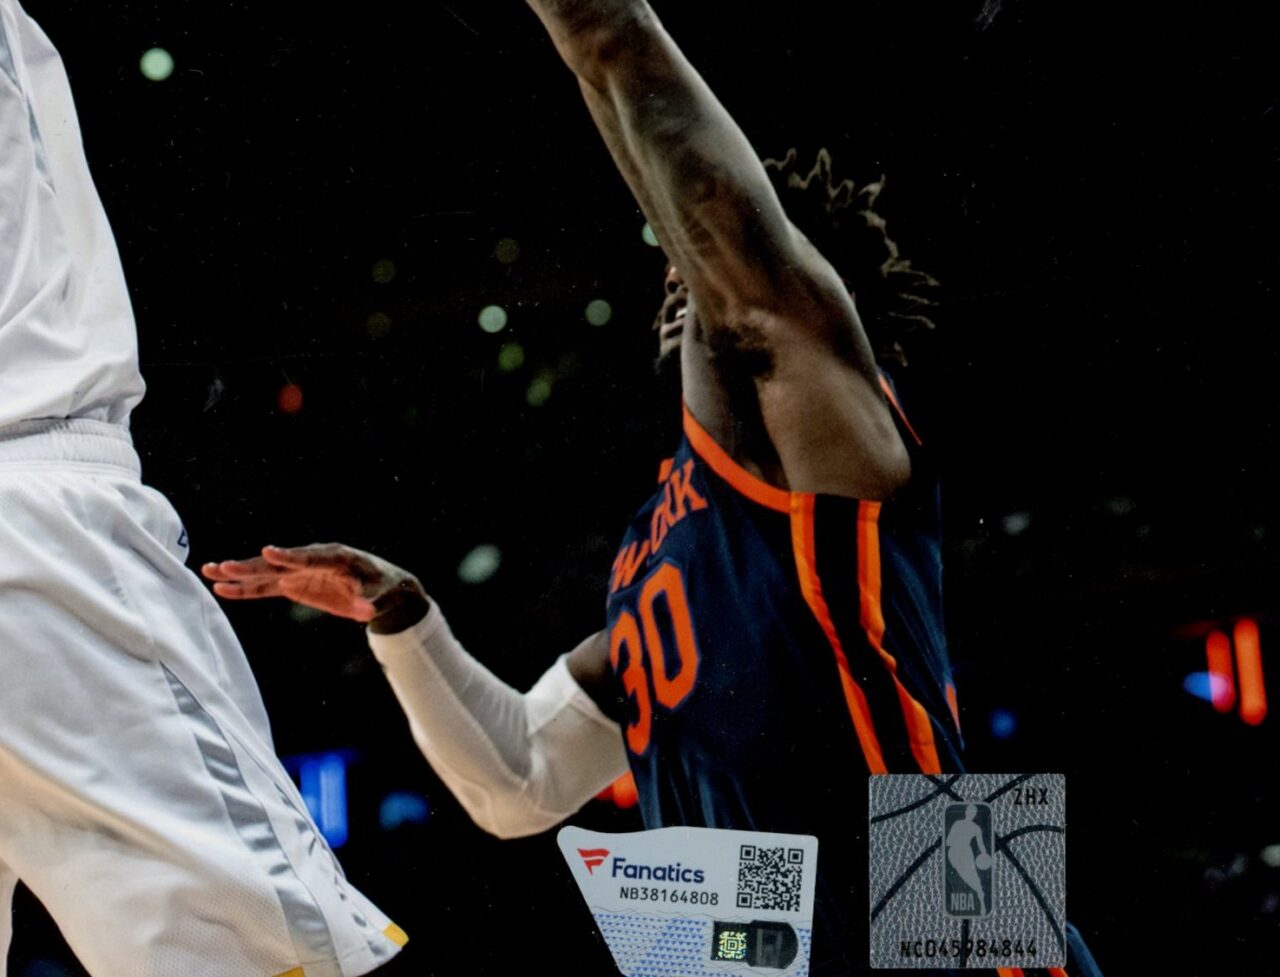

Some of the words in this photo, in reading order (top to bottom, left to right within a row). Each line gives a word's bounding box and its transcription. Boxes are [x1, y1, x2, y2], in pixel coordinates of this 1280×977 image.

[609, 561, 699, 756] 30
[1014, 788, 1049, 806] ZHX
[611, 857, 705, 884] Fanatics
[619, 886, 719, 906] NB38164808
[950, 892, 975, 912] NBA
